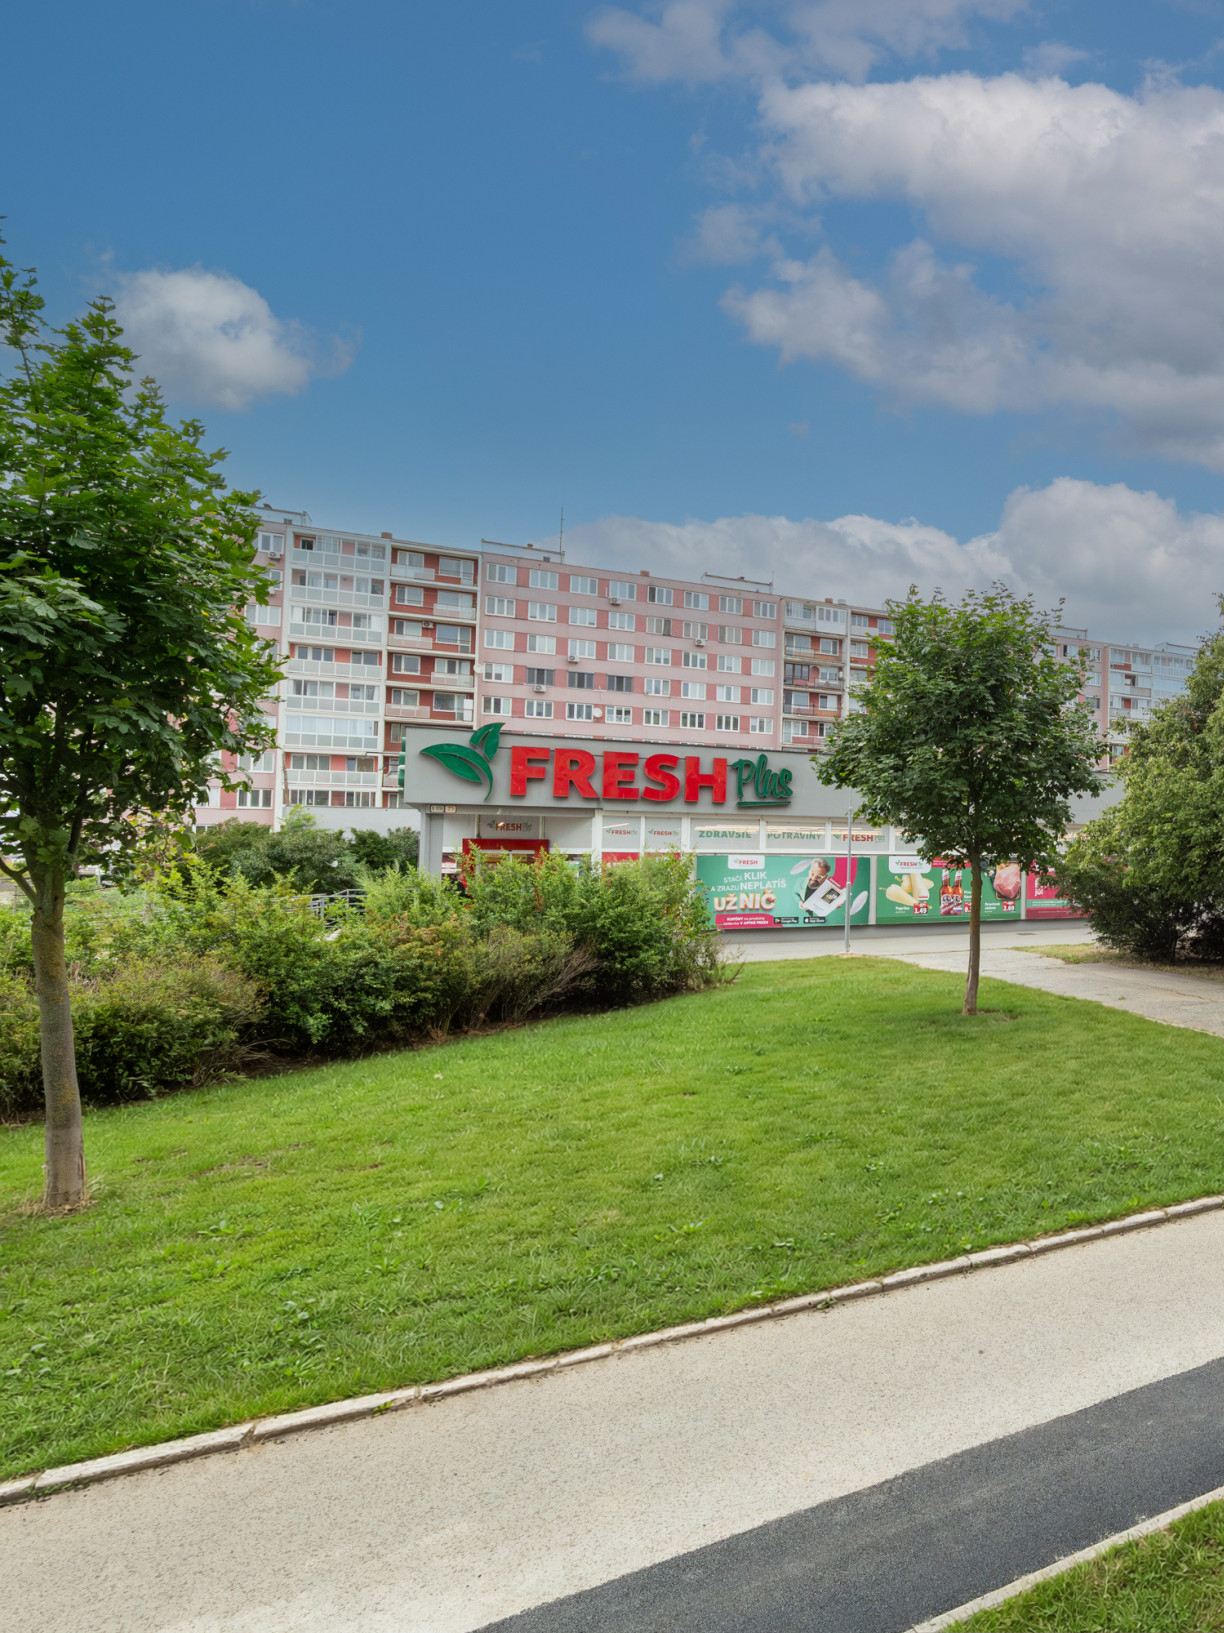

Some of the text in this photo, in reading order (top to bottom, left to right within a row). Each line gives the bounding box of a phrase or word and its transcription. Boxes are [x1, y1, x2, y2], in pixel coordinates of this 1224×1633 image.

[510, 745, 793, 803] FRESH Plus
[495, 822, 522, 832] FRESH
[842, 834, 874, 842] FRESH
[744, 871, 767, 880] KLIK
[740, 878, 787, 890] NEPLATÍŠ
[713, 889, 776, 911] UŽ NIČ
